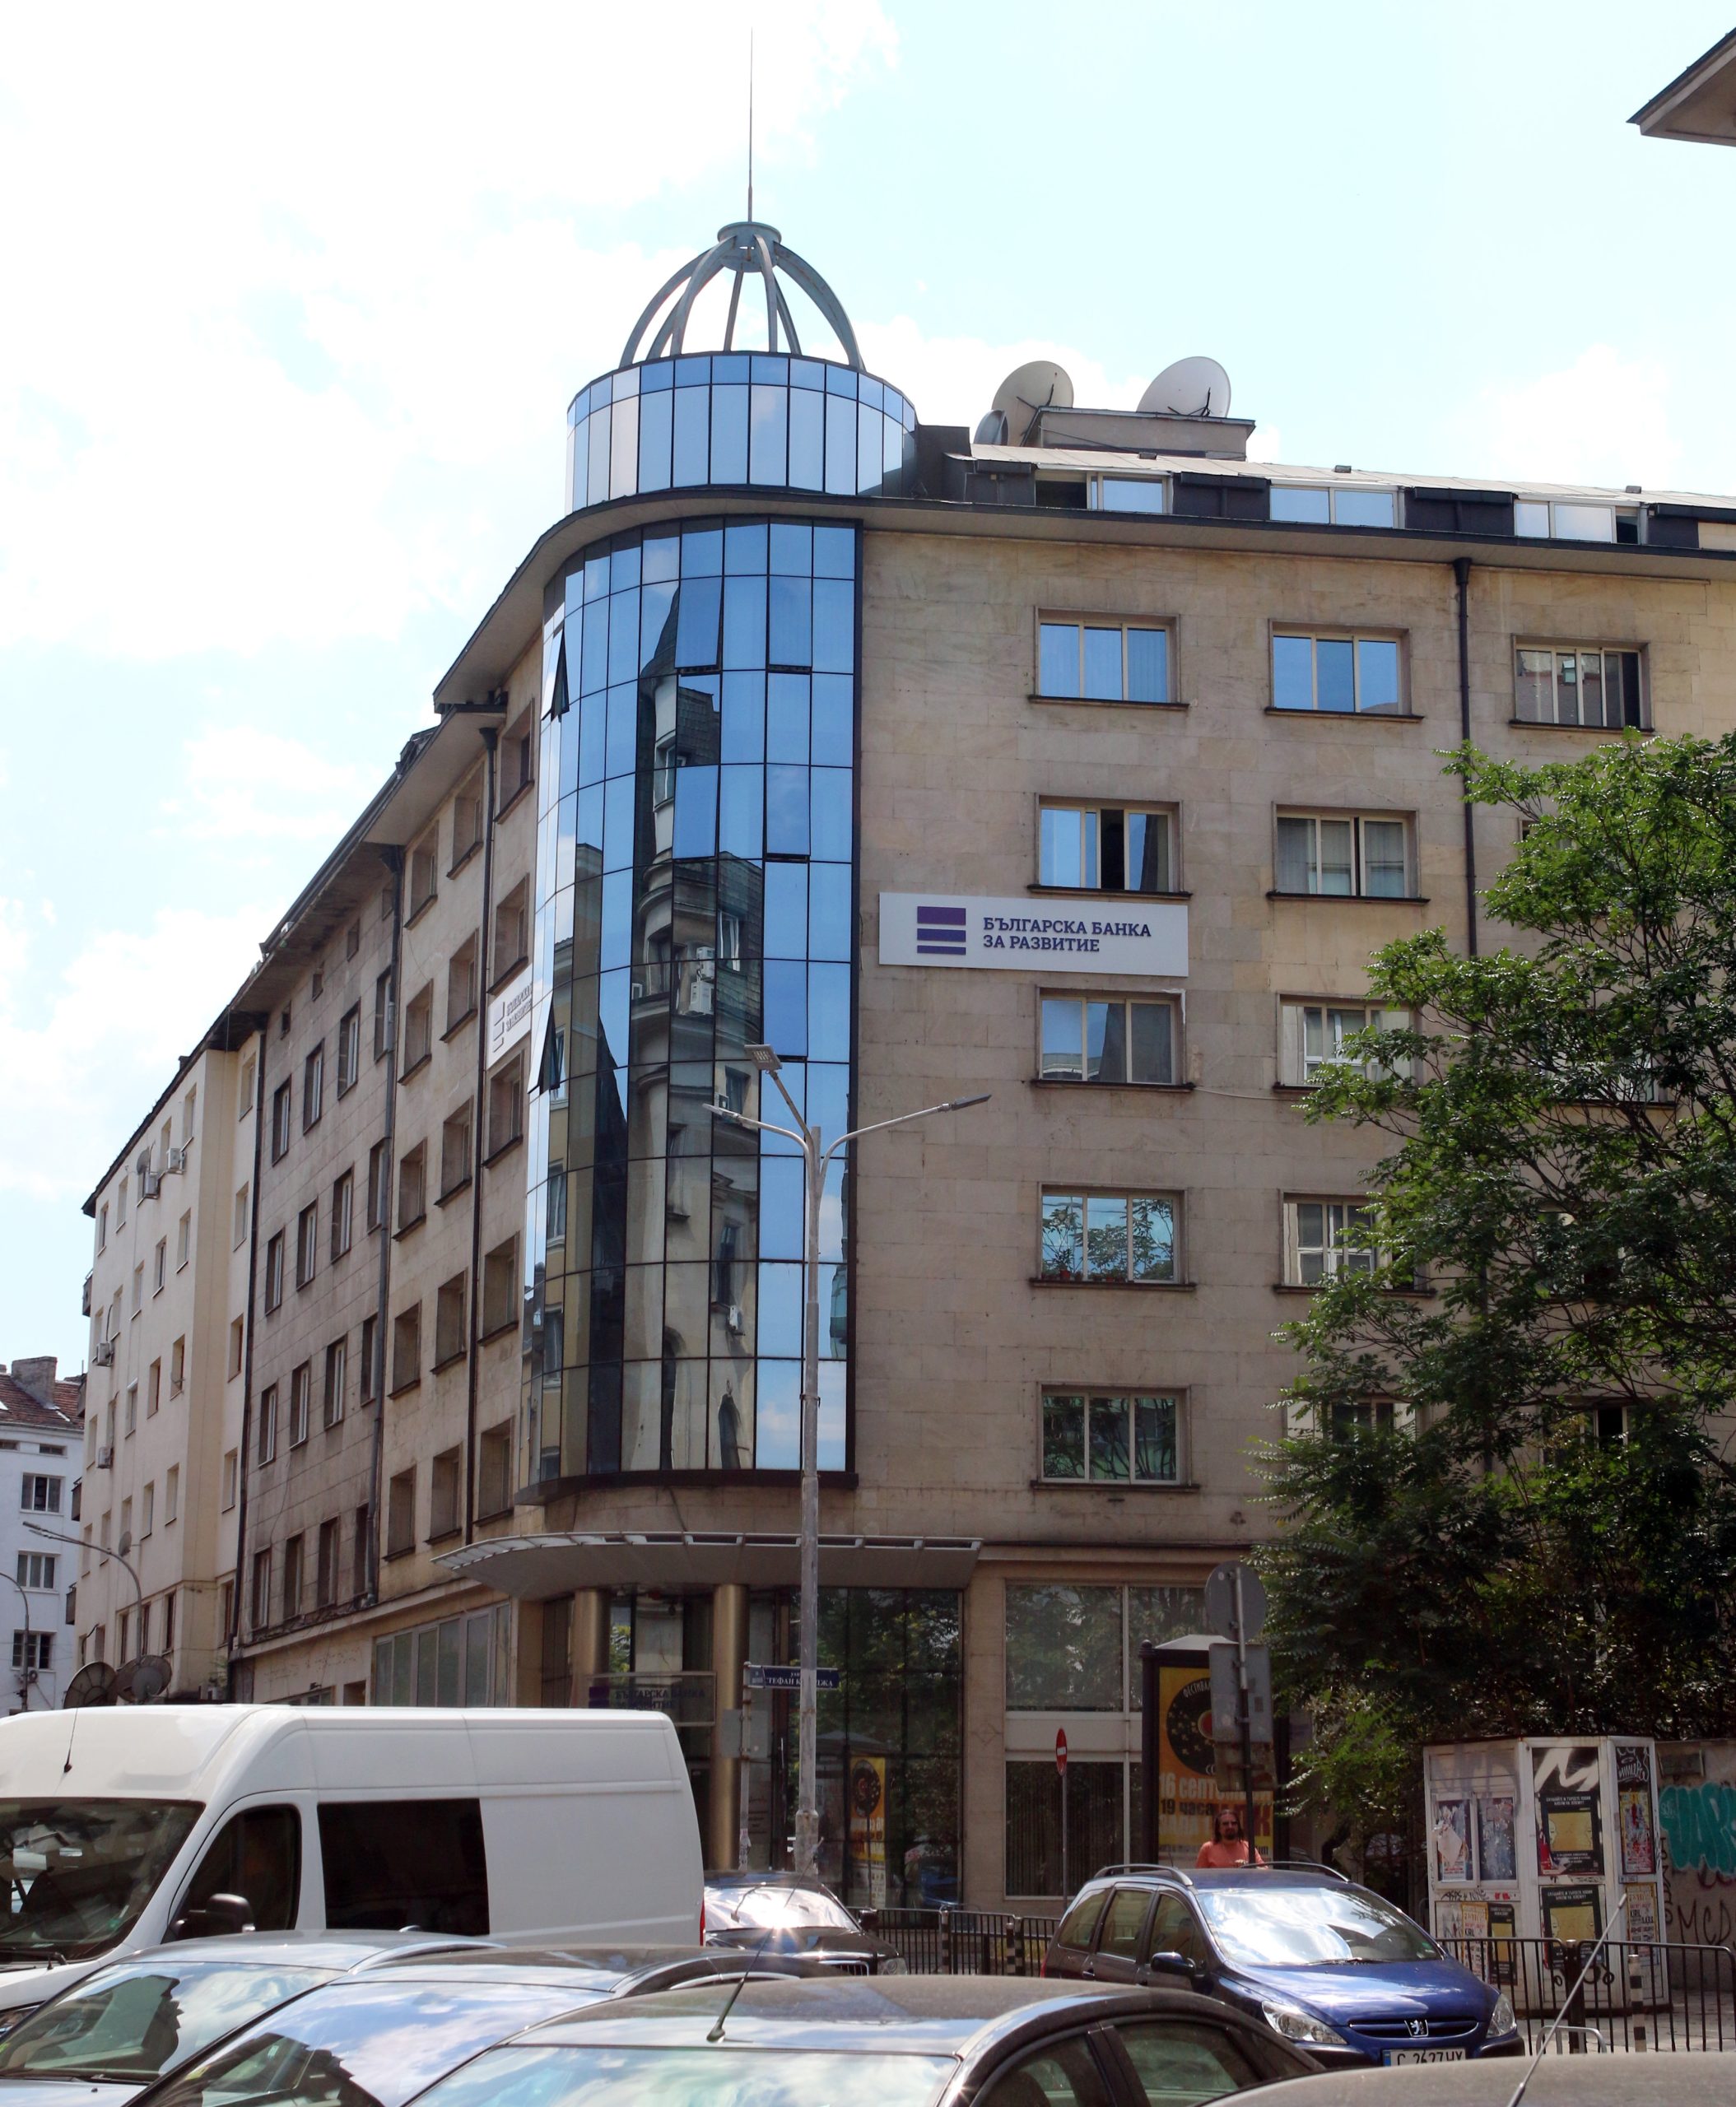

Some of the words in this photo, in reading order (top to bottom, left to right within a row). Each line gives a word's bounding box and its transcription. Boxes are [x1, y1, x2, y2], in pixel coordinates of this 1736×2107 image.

[984, 917, 1087, 935] БЪЛГАРСКА
[1091, 921, 1152, 937] БАНКА
[983, 934, 1006, 948] ЗА
[1009, 936, 1100, 952] РАЗВИТИЕ
[766, 1677, 794, 1686] ТЕФАН
[1161, 1799, 1175, 1815] 19
